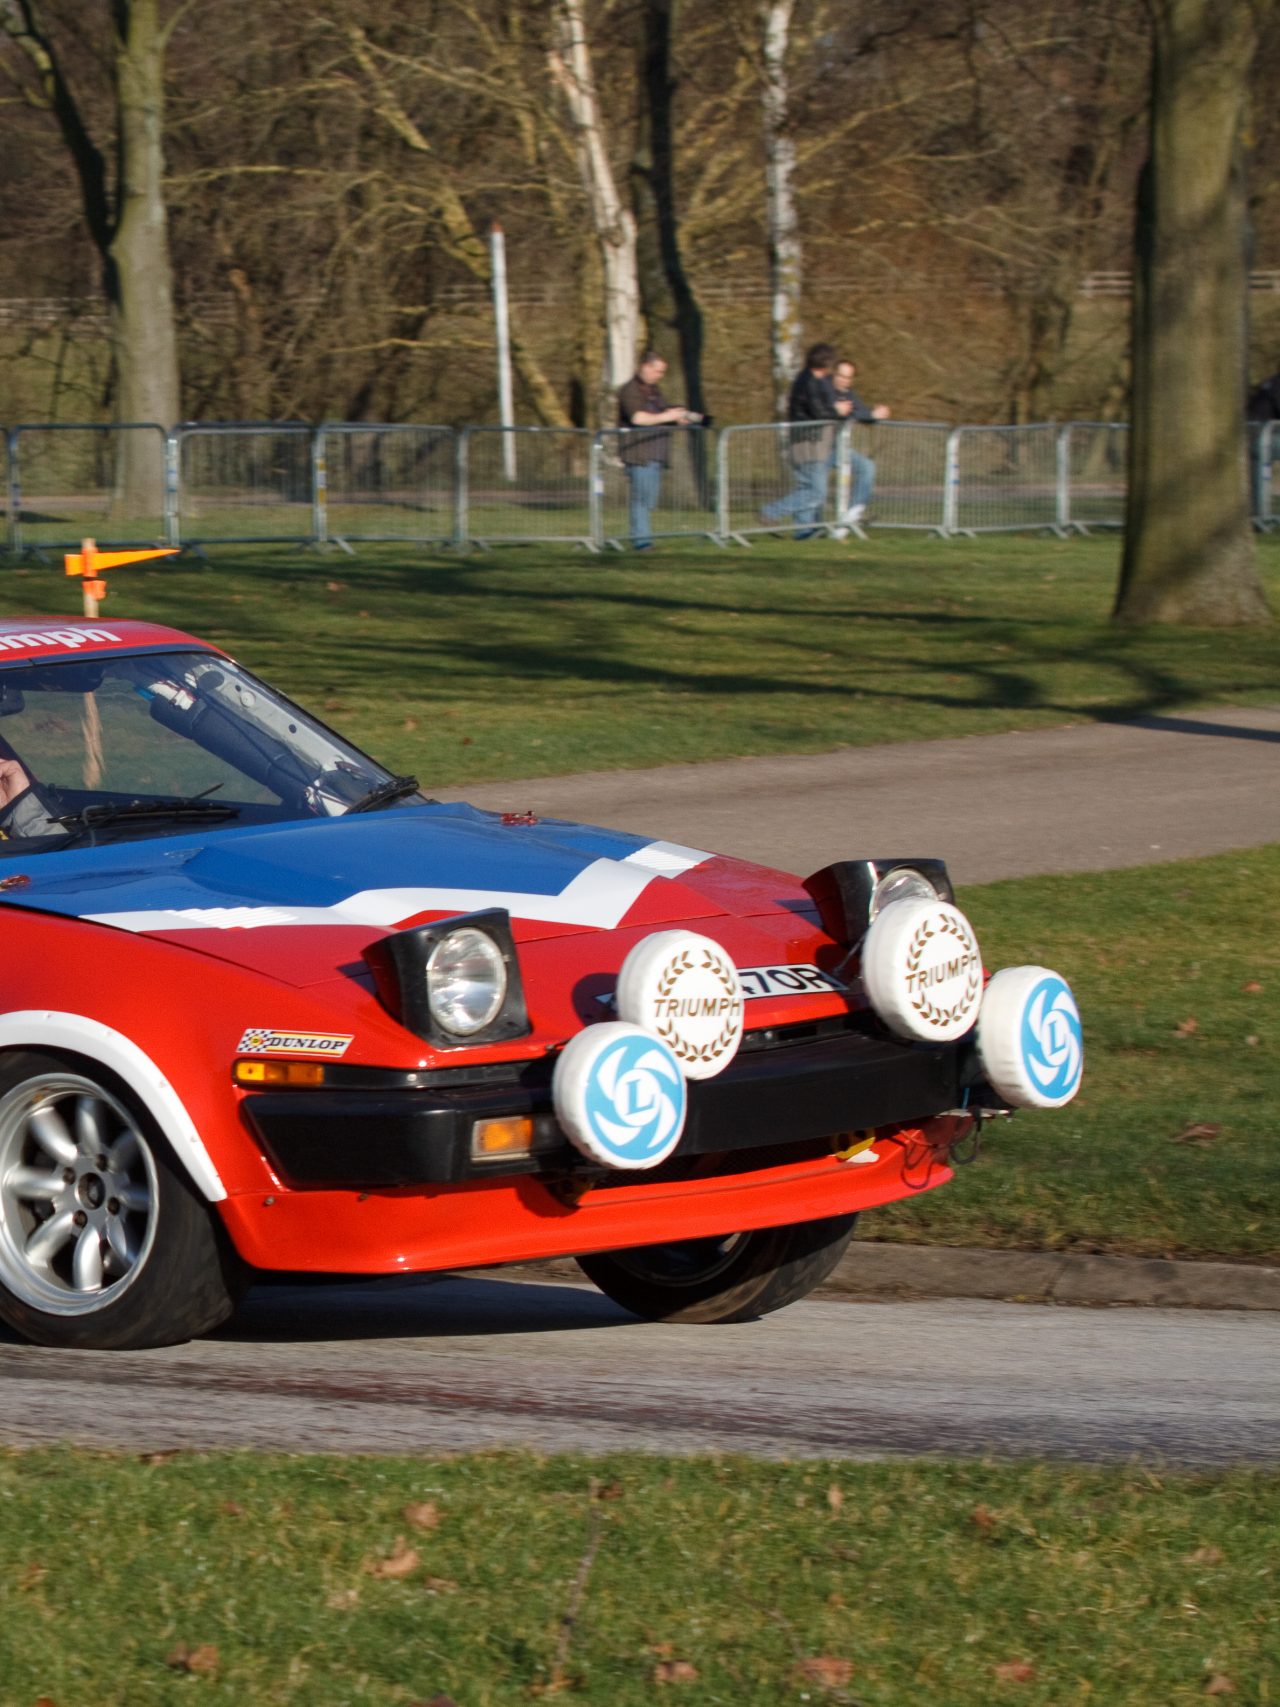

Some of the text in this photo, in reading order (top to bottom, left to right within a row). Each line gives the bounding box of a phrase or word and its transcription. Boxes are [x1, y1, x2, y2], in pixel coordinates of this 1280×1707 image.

[904, 954, 979, 994] TRIUMPH
[653, 998, 741, 1018] TRIUMPH
[266, 1037, 345, 1050] DUNLOP
[1046, 1019, 1069, 1057] L
[625, 1079, 655, 1116] L
